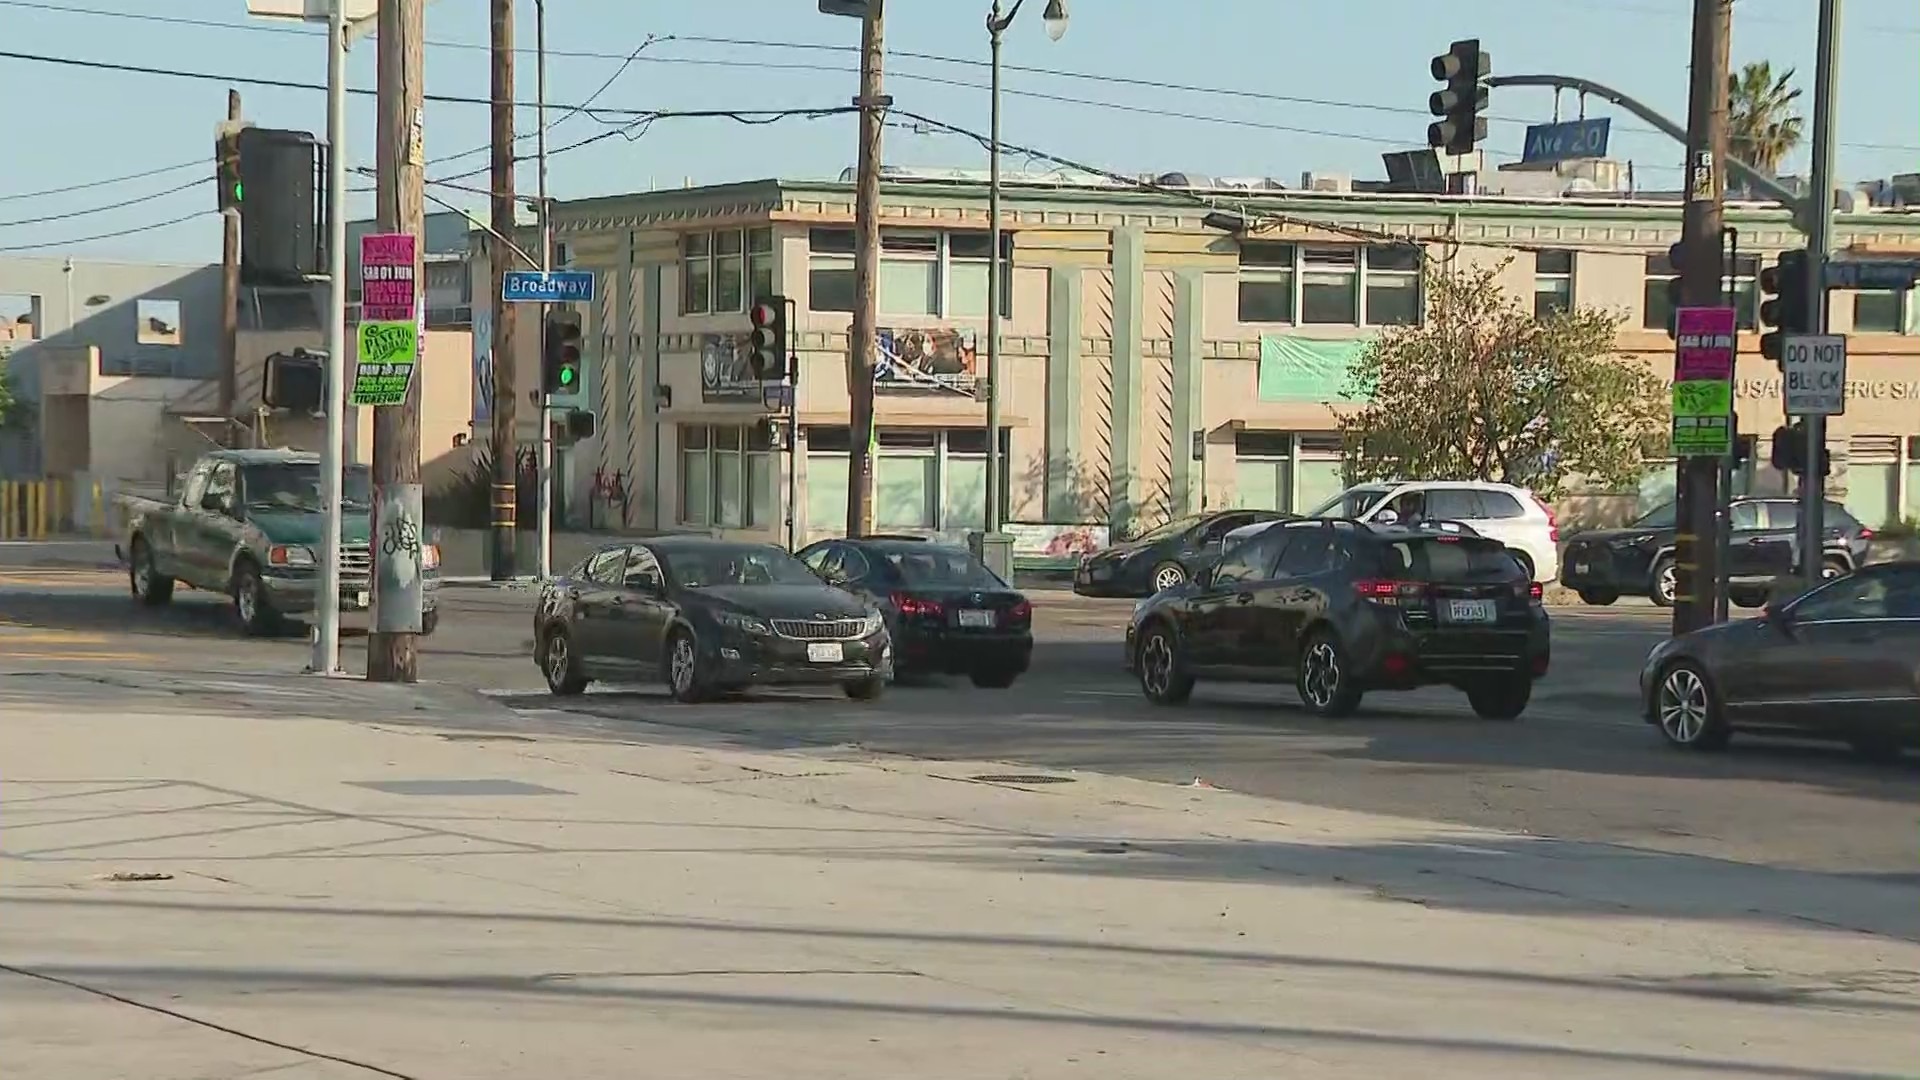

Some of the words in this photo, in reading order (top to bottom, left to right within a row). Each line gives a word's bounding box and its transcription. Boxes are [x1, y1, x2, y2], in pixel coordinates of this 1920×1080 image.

[1531, 135, 1562, 155] Ave
[380, 266, 392, 280] 01
[510, 276, 587, 296] Broadway
[1788, 344, 1808, 363] DO
[1814, 344, 1843, 363] NOT
[1789, 370, 1840, 390] BLCK
